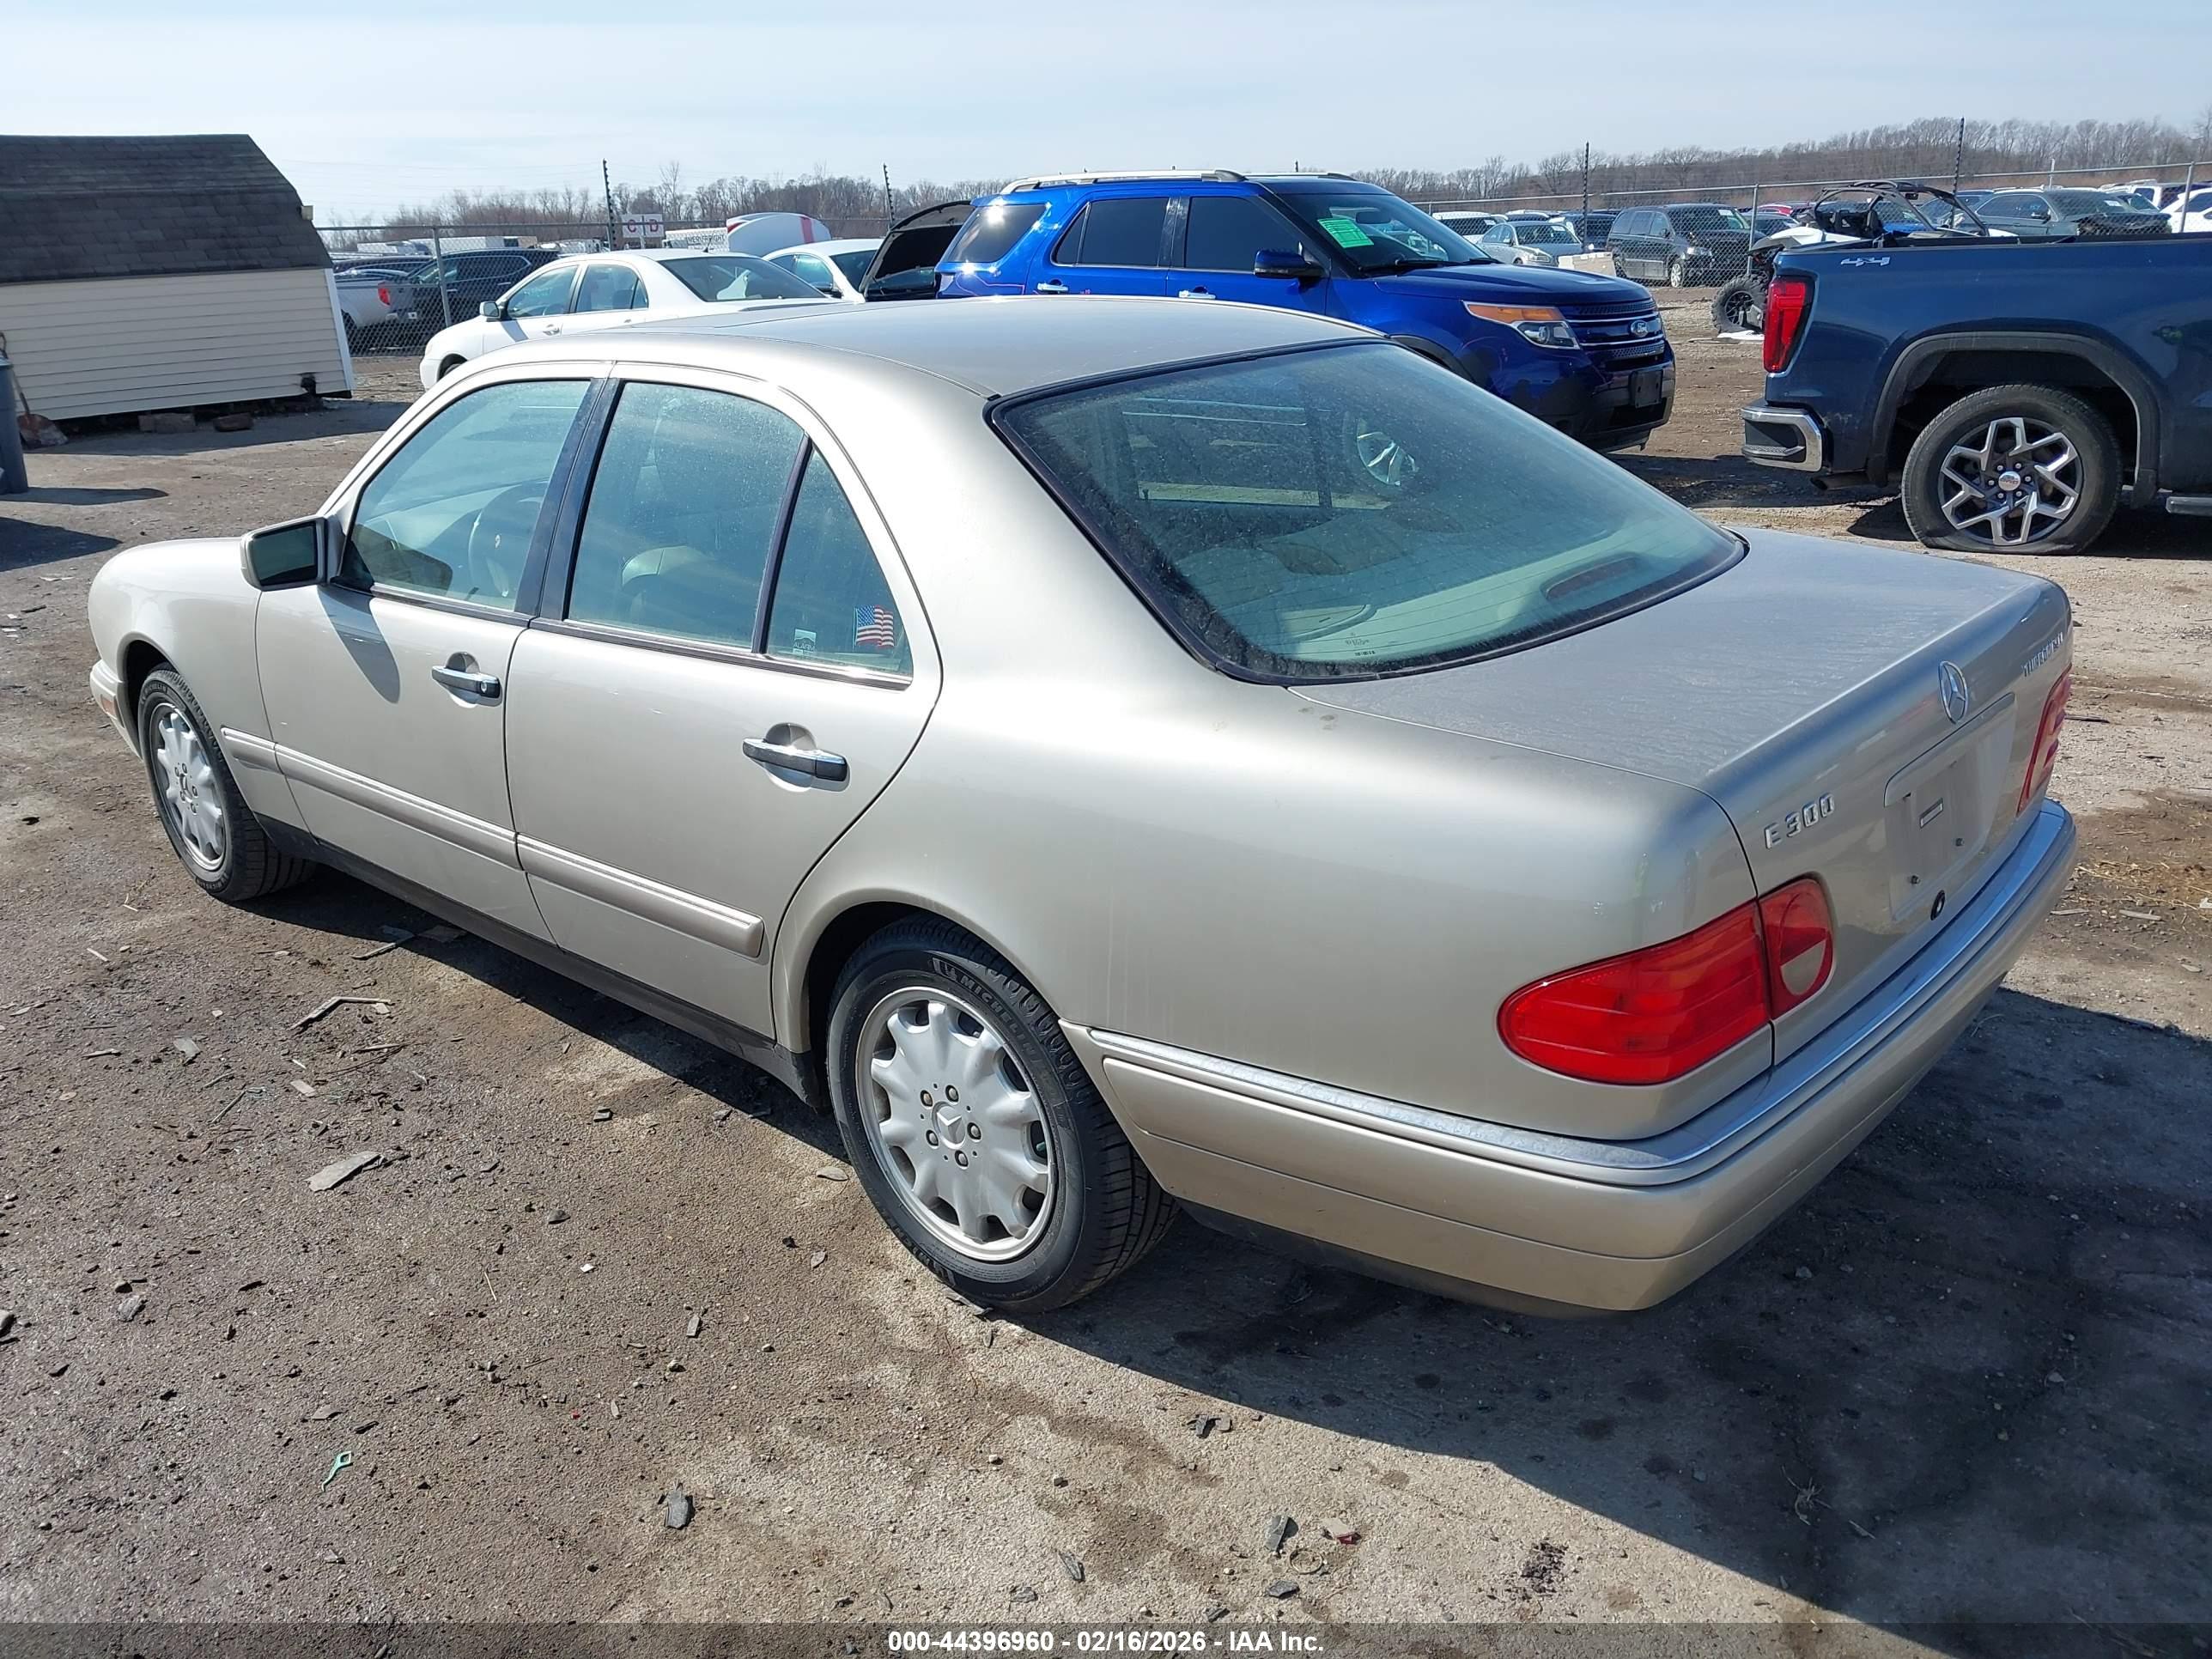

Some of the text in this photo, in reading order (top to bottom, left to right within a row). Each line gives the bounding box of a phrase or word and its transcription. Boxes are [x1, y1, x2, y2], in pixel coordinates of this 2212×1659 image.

[627, 219, 659, 233] C D
[793, 641, 816, 653] ALARM
[1764, 793, 1835, 849] E 300
[959, 975, 1043, 1064] MICHELIN
